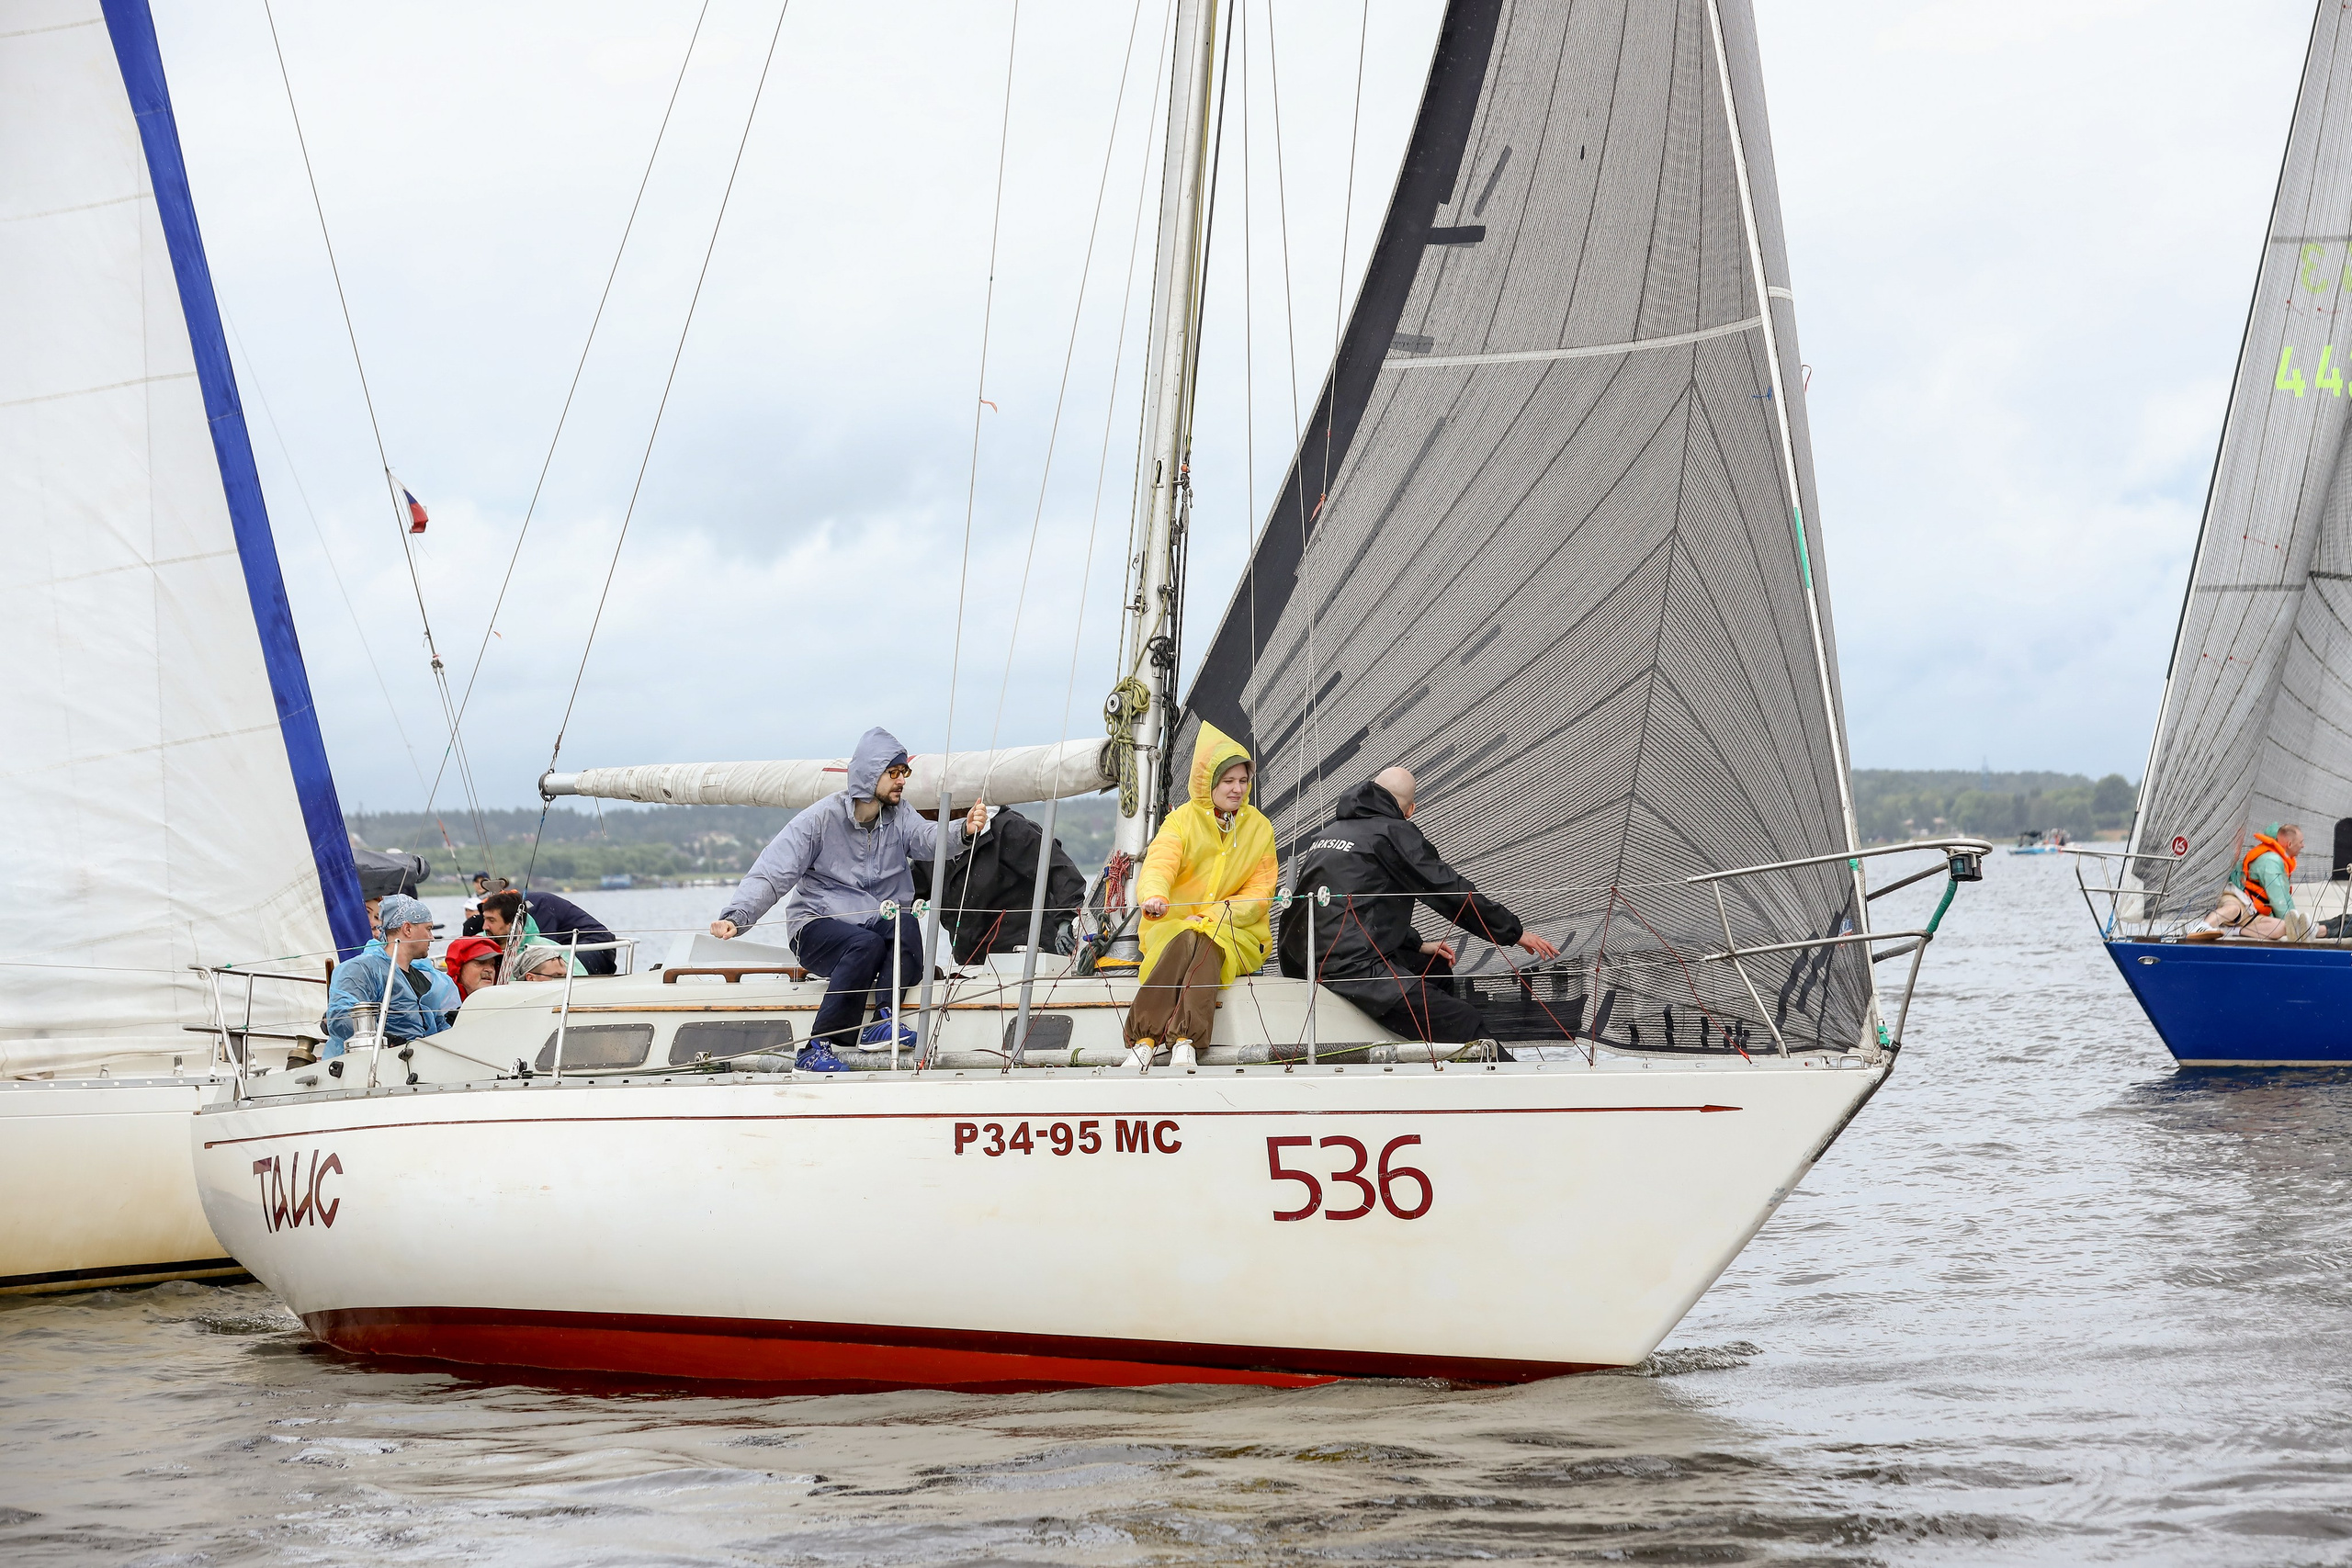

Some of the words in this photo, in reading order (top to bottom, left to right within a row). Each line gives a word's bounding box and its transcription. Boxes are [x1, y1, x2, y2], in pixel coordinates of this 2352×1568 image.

[2276, 344, 2352, 398] 44
[955, 1121, 1102, 1157] Р34-95
[1115, 1120, 1182, 1154] МС
[1267, 1134, 1433, 1222] 536
